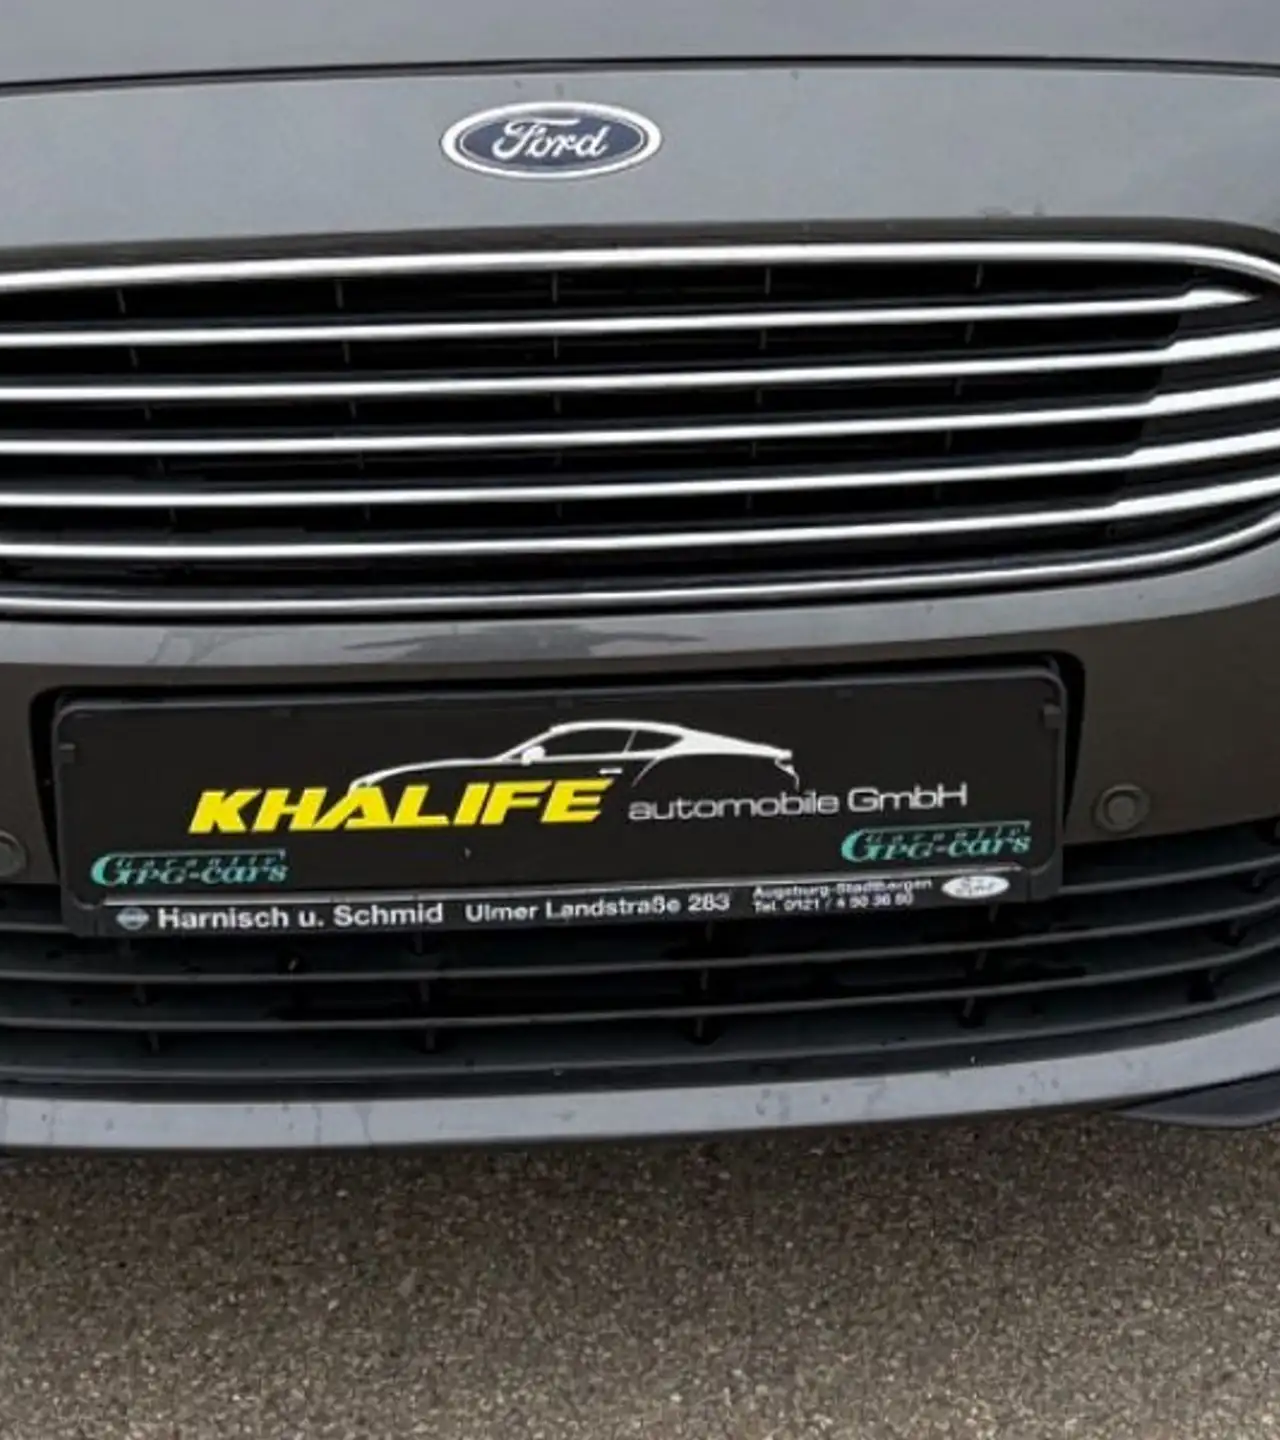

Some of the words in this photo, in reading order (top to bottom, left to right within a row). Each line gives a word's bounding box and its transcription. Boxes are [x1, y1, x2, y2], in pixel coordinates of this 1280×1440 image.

[491, 116, 611, 159] Ford
[187, 776, 615, 835] KHALIFE
[628, 789, 840, 821] automobile
[847, 782, 967, 813] GmbH
[157, 907, 289, 929] Harnisch
[298, 910, 324, 928] u.
[332, 903, 443, 927] Schmid
[464, 903, 537, 922] Ulmer
[545, 894, 682, 919] Landstraße
